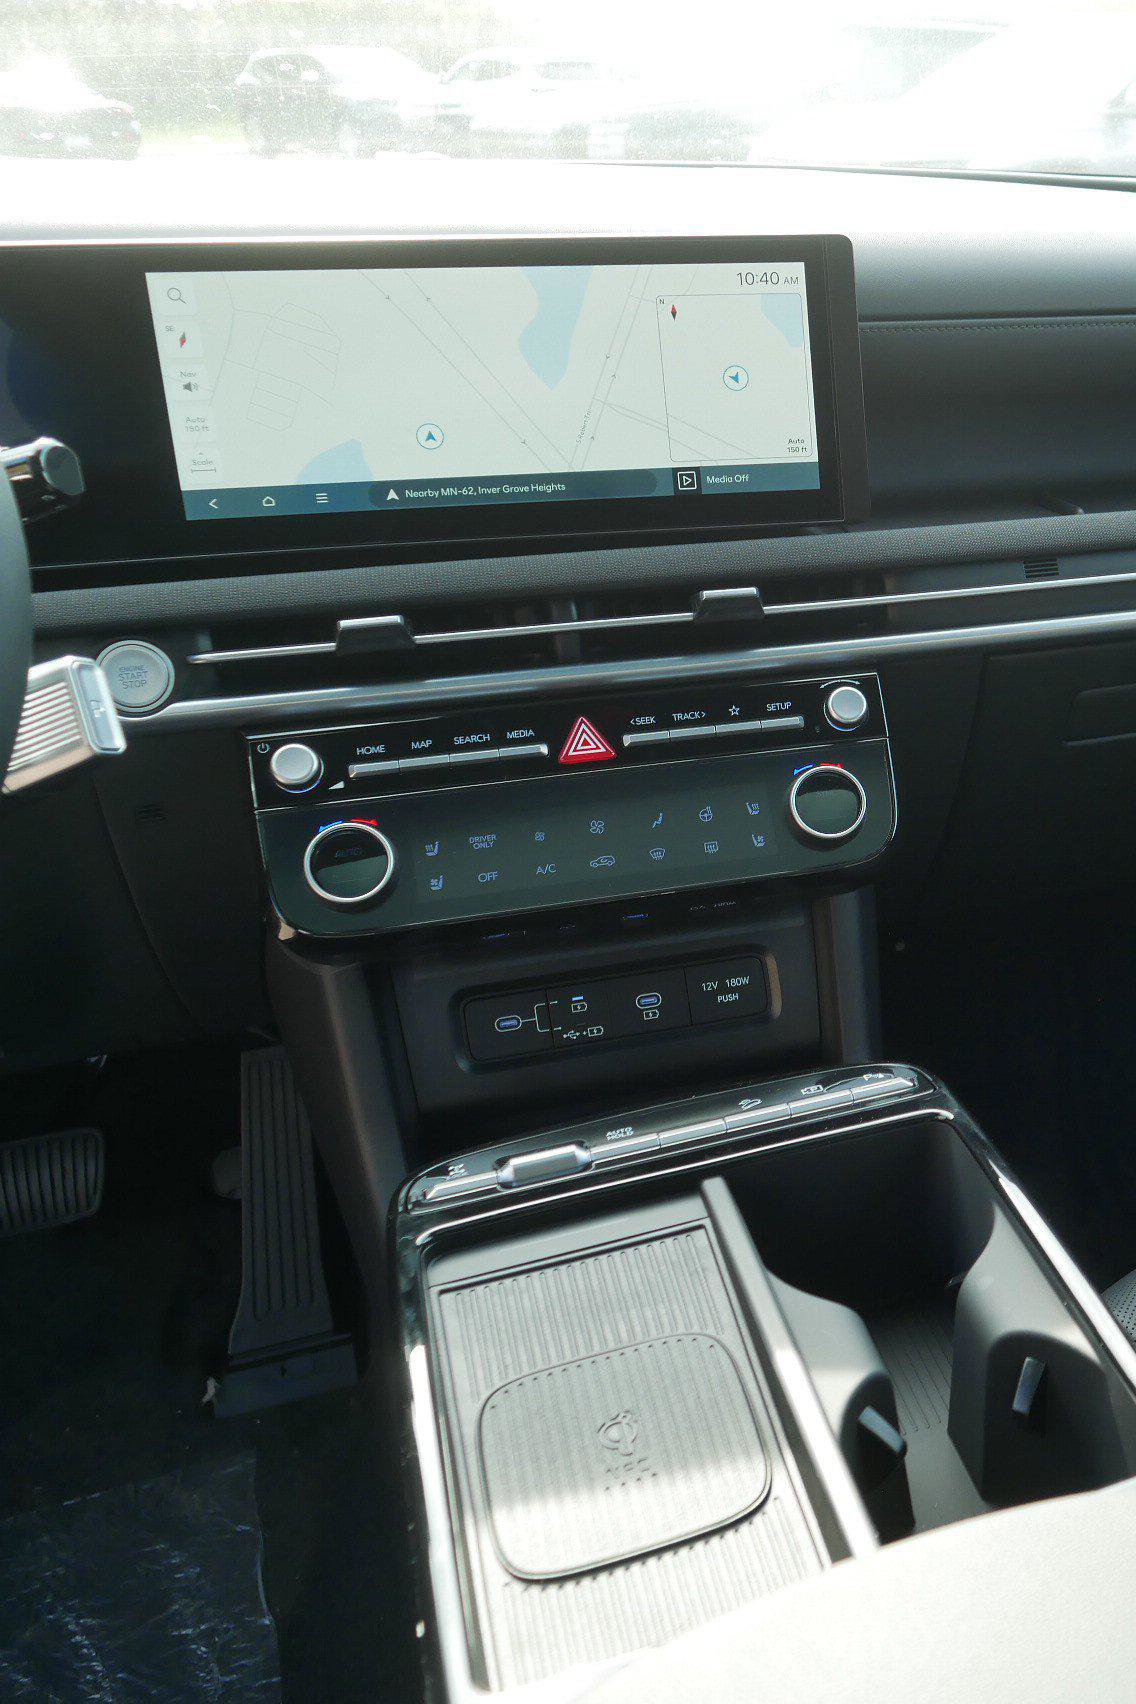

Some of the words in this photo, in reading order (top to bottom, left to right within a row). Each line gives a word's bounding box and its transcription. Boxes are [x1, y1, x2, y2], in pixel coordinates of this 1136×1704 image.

[736, 271, 780, 286] 10:40
[783, 276, 799, 285] AM
[179, 370, 197, 379] Nav
[185, 416, 206, 424] Auto
[787, 437, 805, 445] Auto
[706, 474, 733, 484] Media
[734, 473, 750, 483] Off
[405, 488, 439, 499] Nearby
[440, 486, 477, 497] MN-62,
[478, 486, 501, 494] Inver
[502, 484, 530, 494] Grove
[531, 482, 566, 493] Heights
[118, 671, 148, 682] START
[122, 680, 148, 690] STOP
[766, 701, 792, 712] SETUP
[356, 744, 386, 756] HOME
[411, 739, 433, 750] MAP
[453, 733, 491, 746] SEARCH
[506, 728, 535, 739] MEDIA
[468, 833, 497, 845] DRIVER
[472, 840, 496, 851] ONLY
[535, 863, 557, 875] A/C
[476, 871, 499, 884] OFF
[700, 980, 719, 992] 12V
[725, 975, 751, 988] 180W
[717, 992, 739, 1004] PUSH
